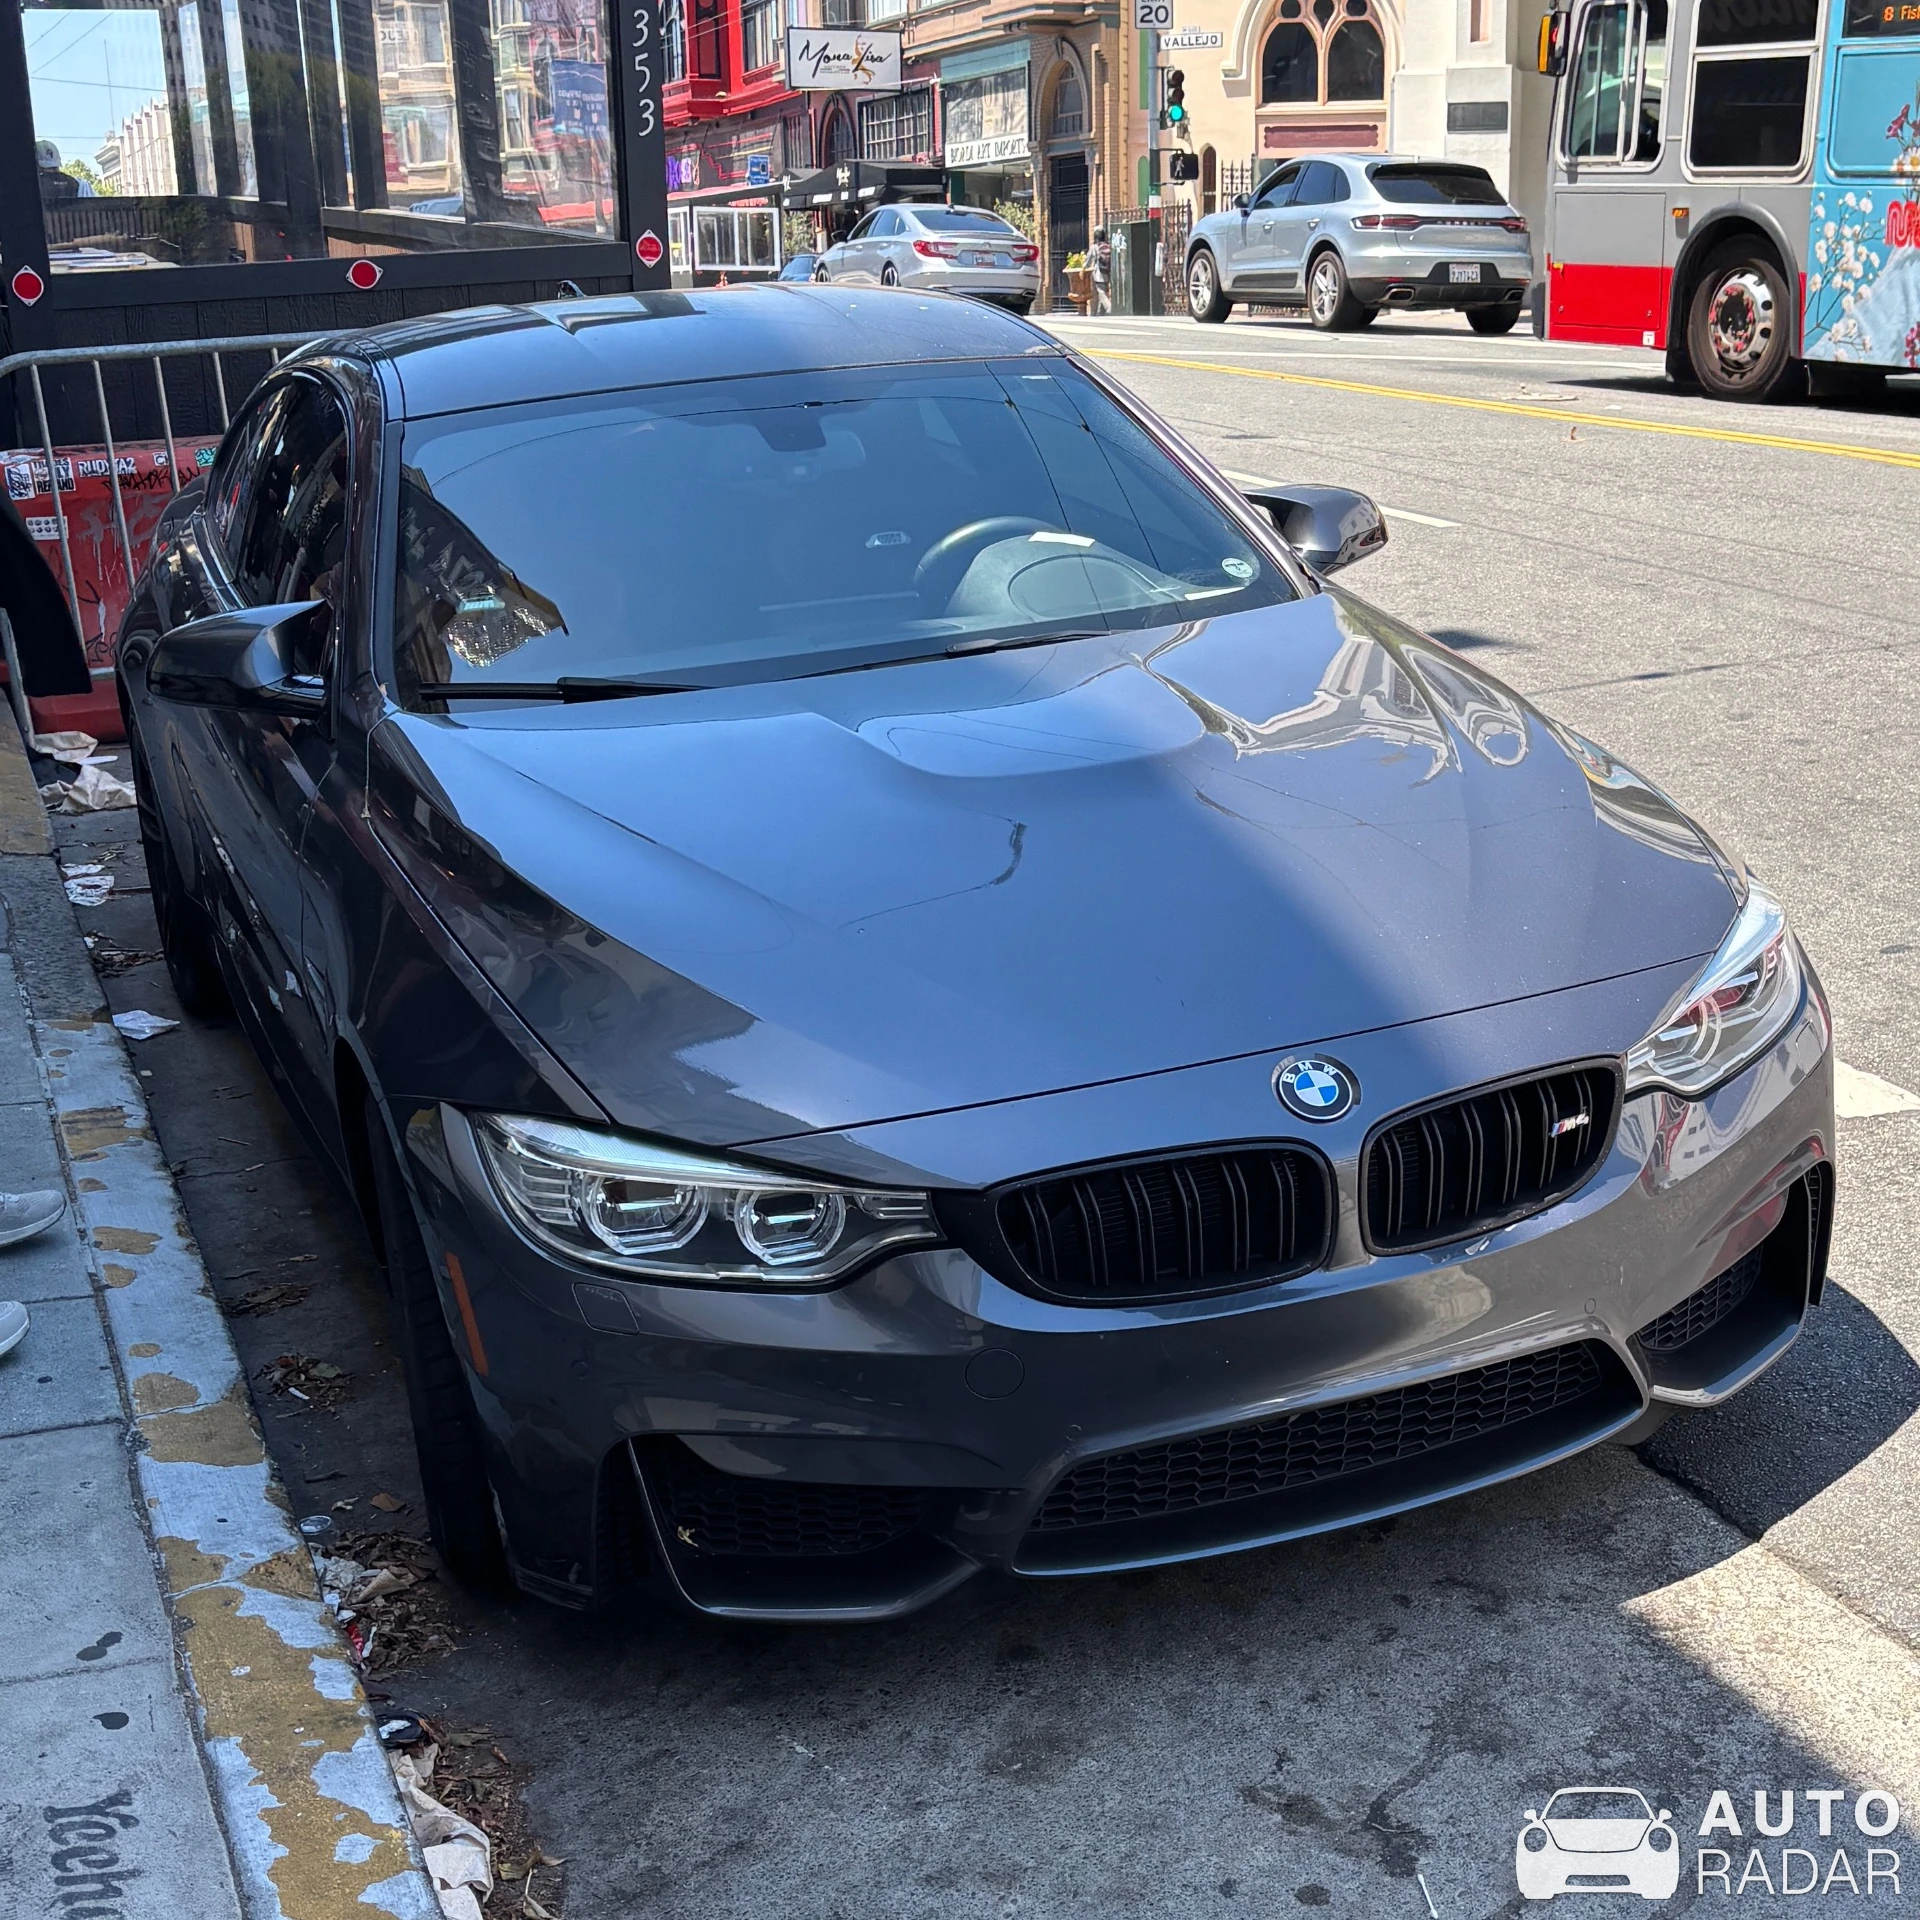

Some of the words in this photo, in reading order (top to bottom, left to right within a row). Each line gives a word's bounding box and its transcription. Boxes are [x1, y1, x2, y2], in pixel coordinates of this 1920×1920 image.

[1139, 5, 1169, 24] 20
[1883, 6, 1895, 21] 8
[1164, 35, 1218, 48] VALLEJO
[798, 39, 852, 79] Mona
[851, 43, 892, 73] Lisa
[1282, 1061, 1337, 1084] BMW
[1559, 1113, 1590, 1133] M4
